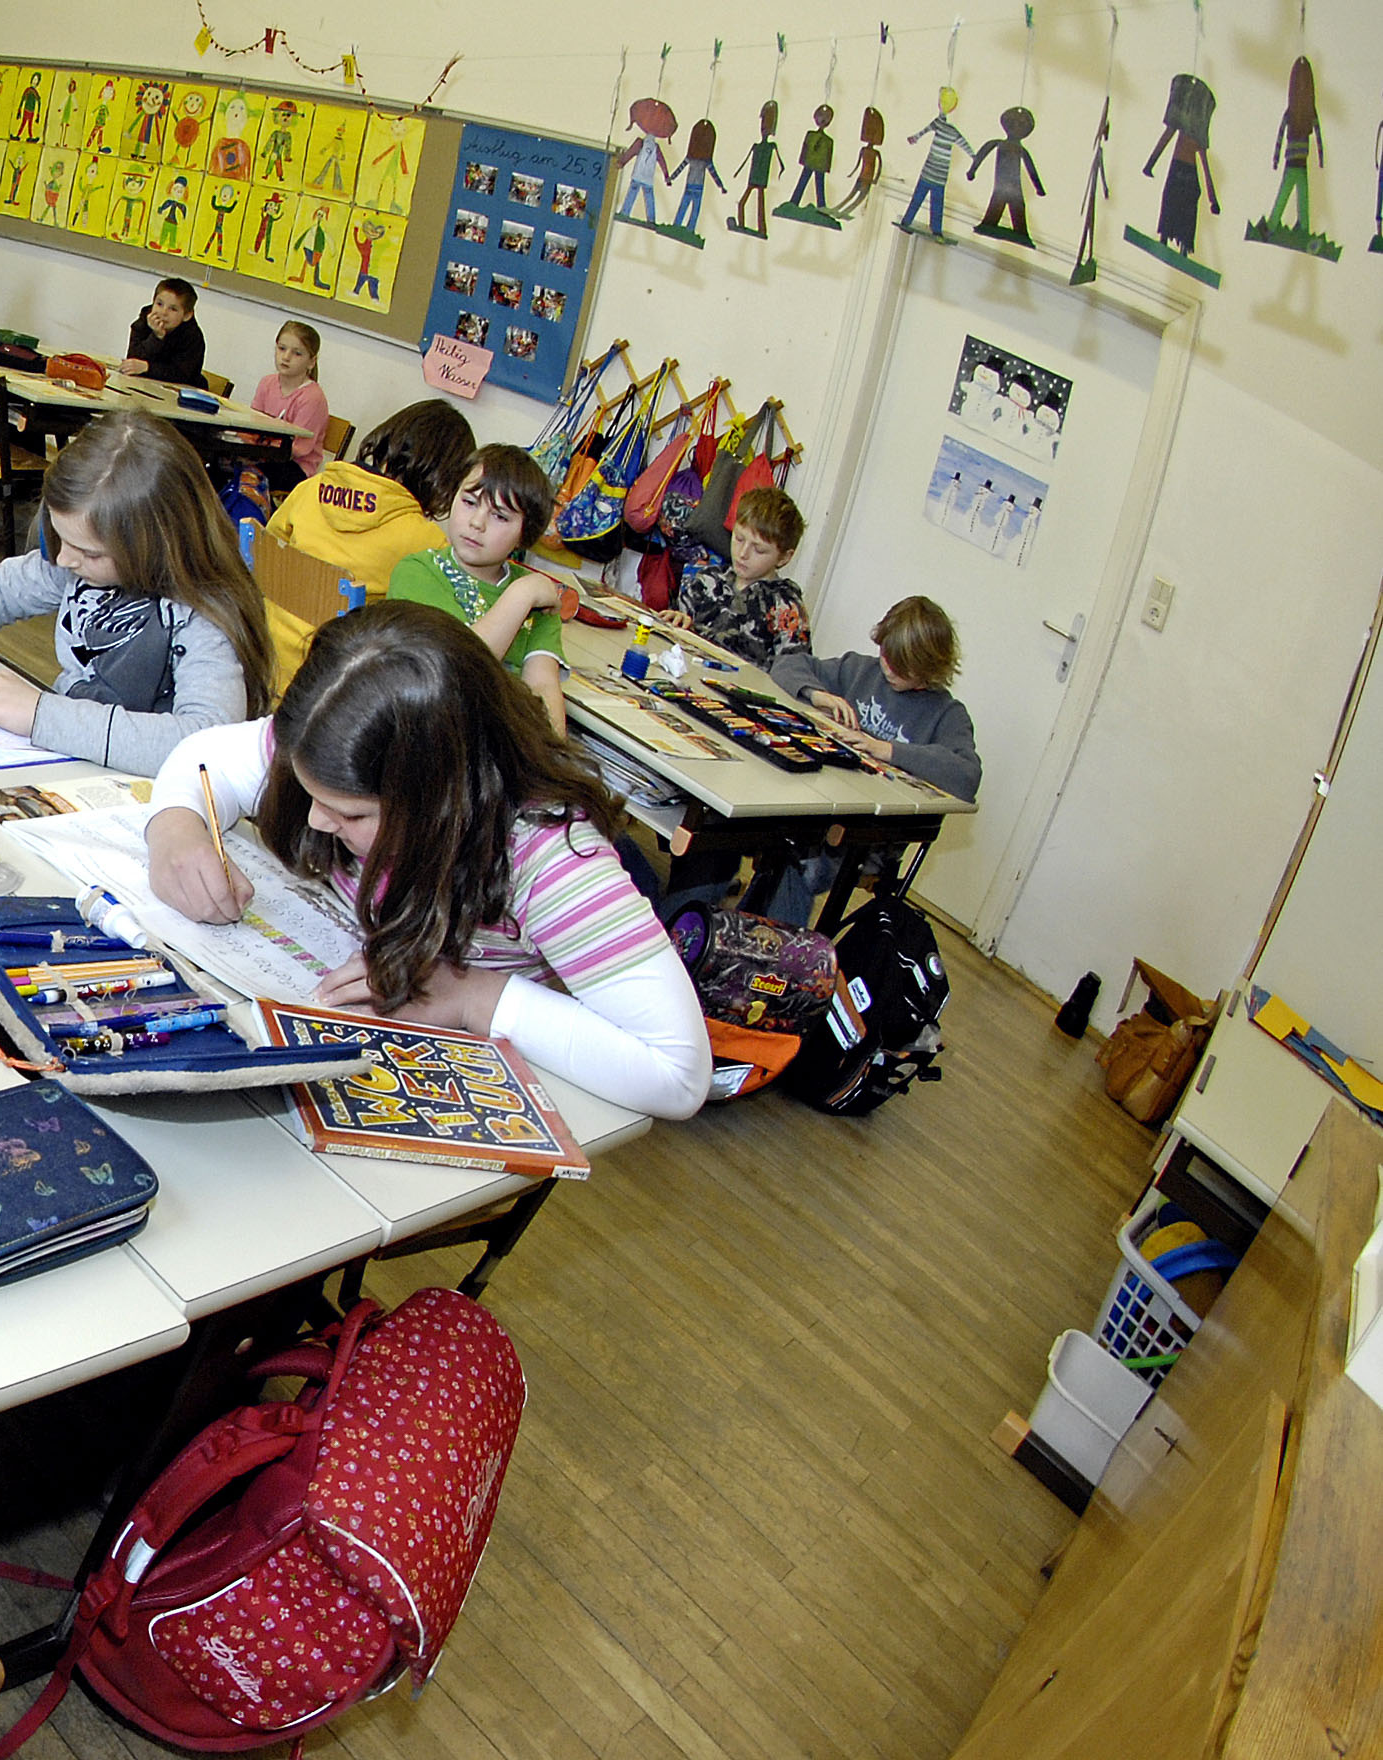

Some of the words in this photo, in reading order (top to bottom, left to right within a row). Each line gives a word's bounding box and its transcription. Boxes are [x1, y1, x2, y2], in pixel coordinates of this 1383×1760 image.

[529, 155, 557, 167] am
[439, 363, 476, 390] Wasser
[319, 483, 377, 513] ROOKIES
[751, 977, 784, 993] Scout
[435, 1041, 548, 1144] BUCH
